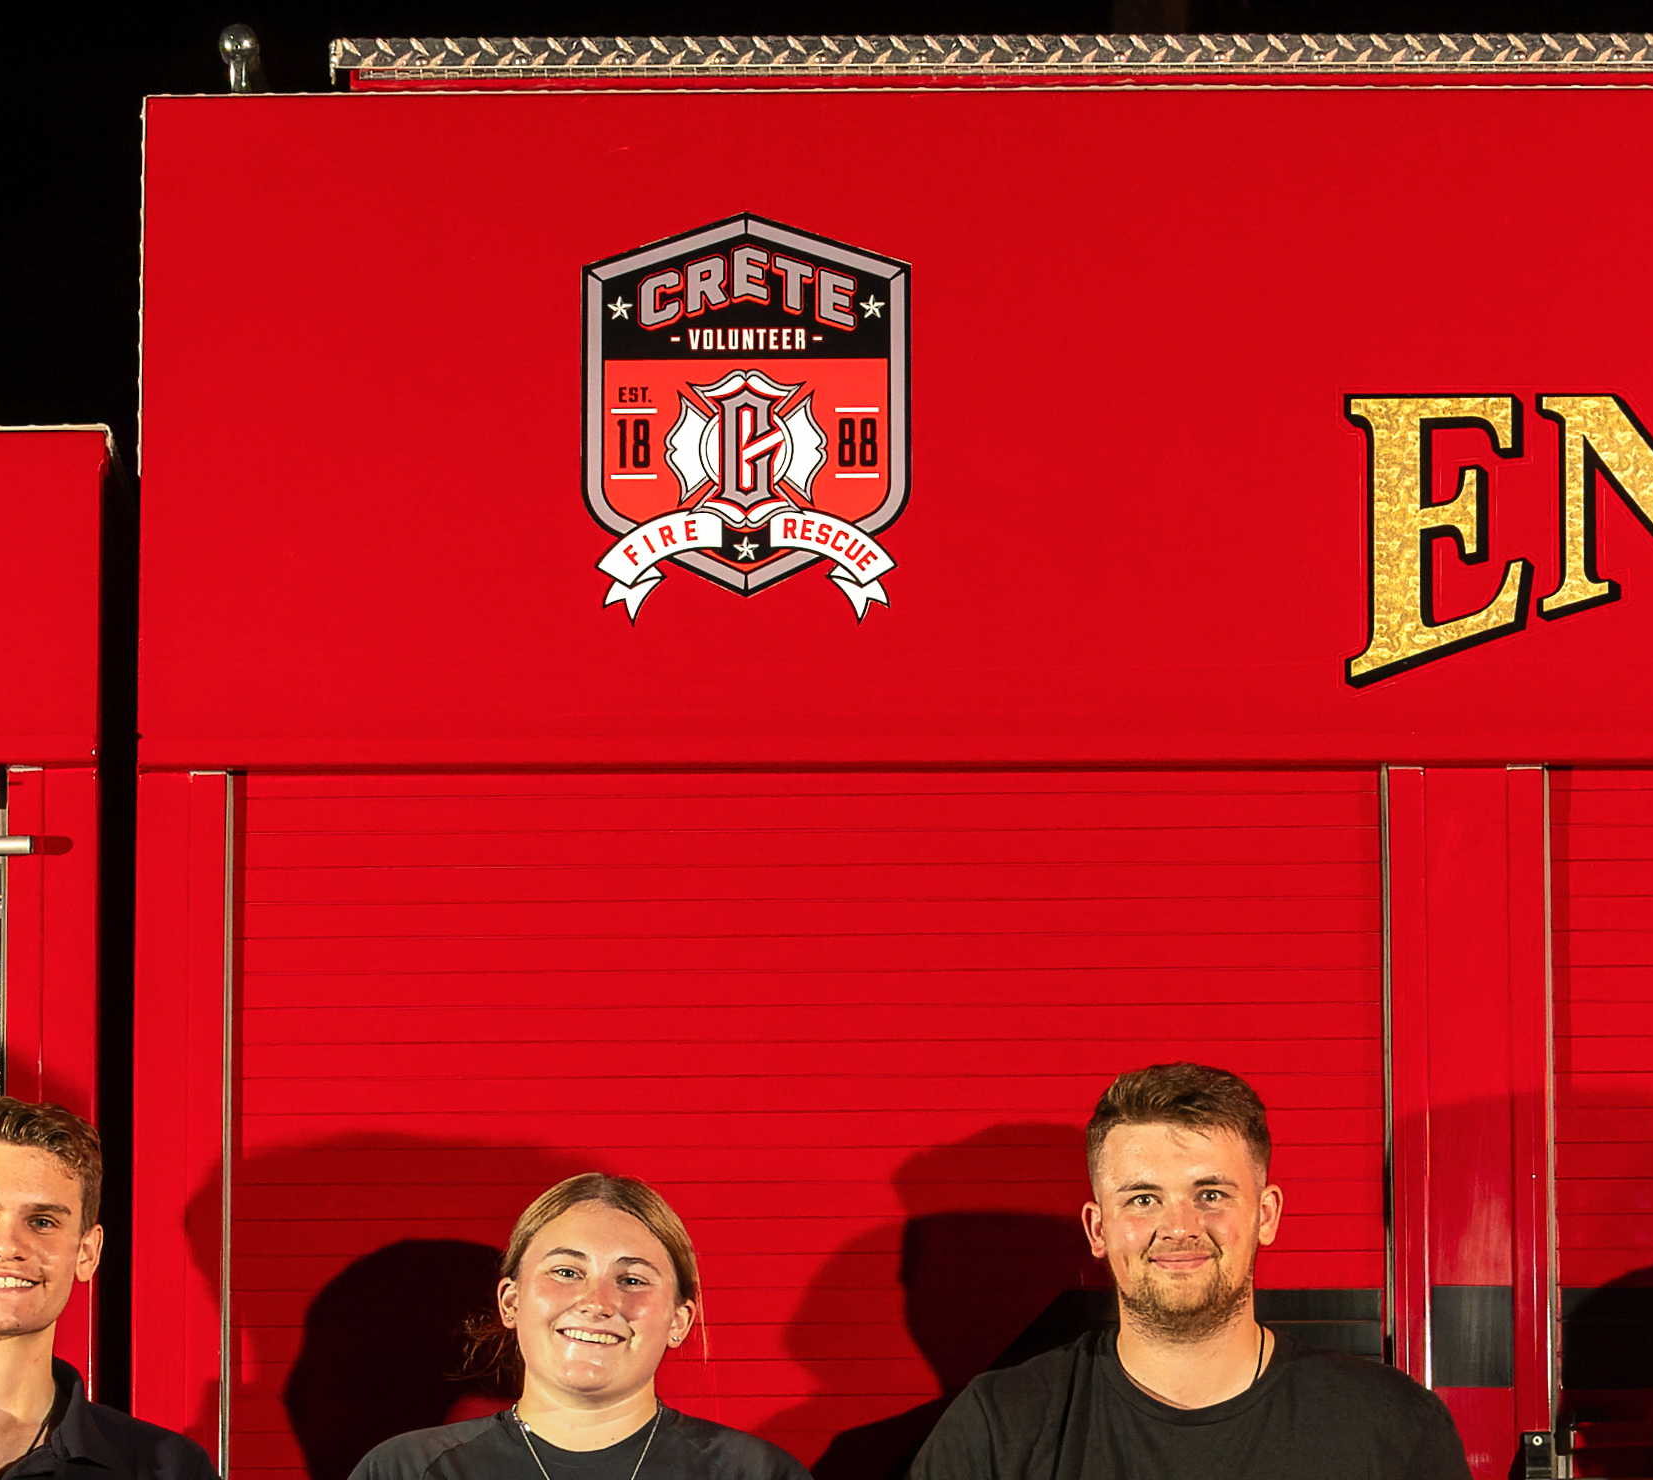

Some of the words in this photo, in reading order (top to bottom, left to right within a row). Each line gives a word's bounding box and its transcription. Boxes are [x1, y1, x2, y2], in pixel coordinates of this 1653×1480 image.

[637, 244, 857, 331] CRETE
[688, 328, 807, 351] VOLUNTEER
[618, 386, 652, 403] EST.
[617, 418, 650, 469] 18
[838, 418, 877, 467] 88
[624, 519, 699, 566] FIRE
[783, 519, 878, 573] RESCUE
